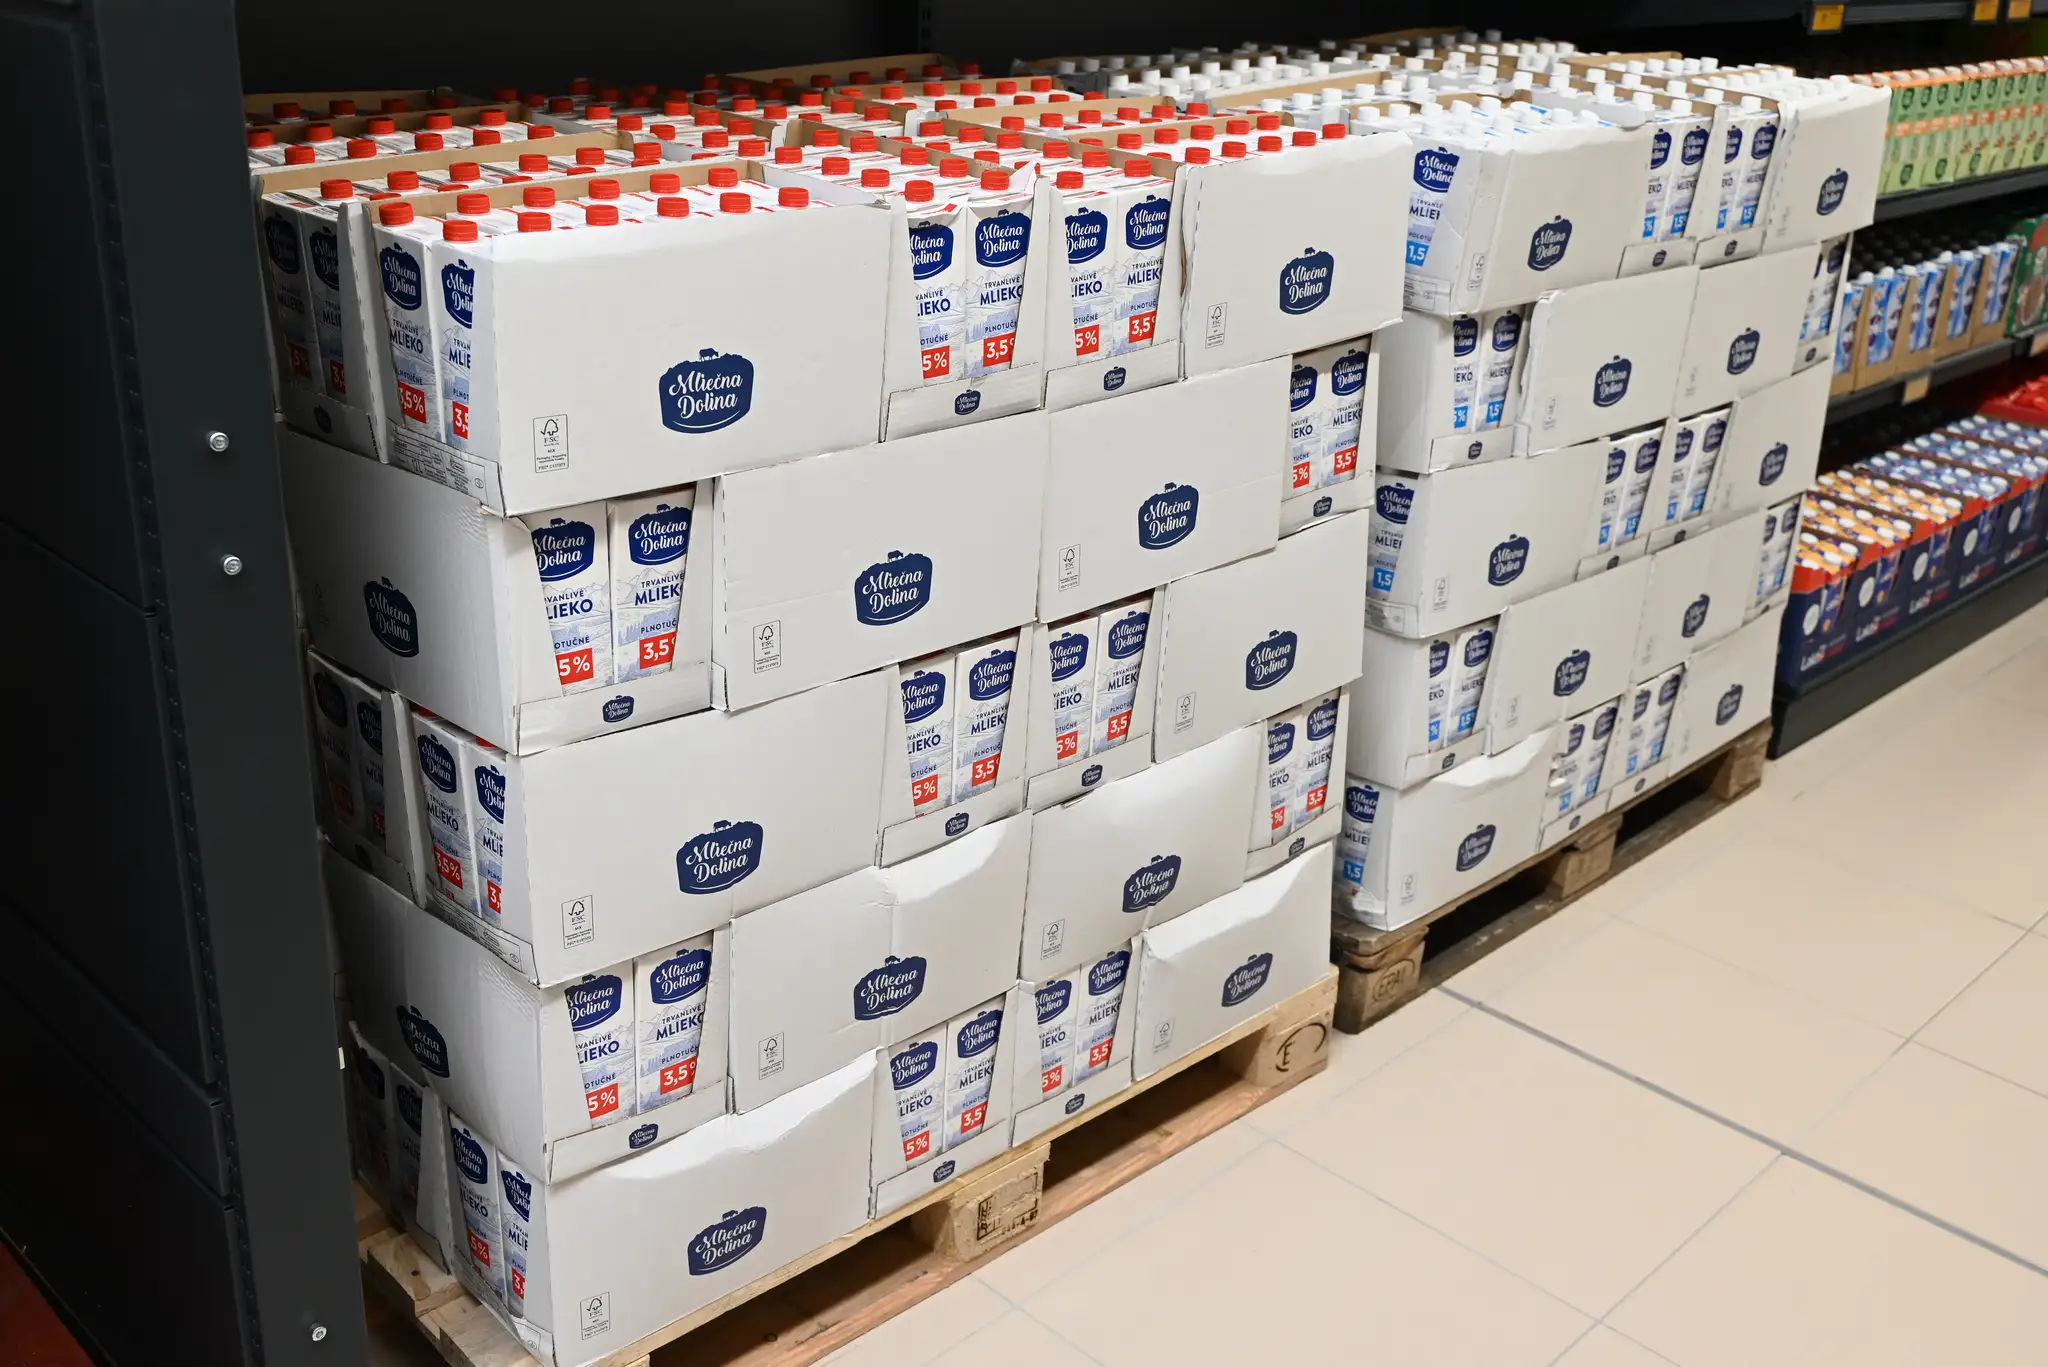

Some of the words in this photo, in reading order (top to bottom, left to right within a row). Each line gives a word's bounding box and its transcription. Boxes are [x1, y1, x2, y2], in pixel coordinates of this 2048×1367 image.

[979, 223, 1024, 242] Mliečna
[1133, 223, 1164, 240] Dolina
[983, 238, 1020, 256] Dolina
[1409, 245, 1426, 261] 1,5
[1284, 265, 1328, 286] Mliečna
[1072, 281, 1102, 298] IEKO
[1289, 283, 1323, 304] Dolina
[917, 300, 950, 317] IEKO
[389, 328, 424, 354] MLIEKO
[1076, 330, 1097, 348] 5%
[922, 351, 947, 371] 5%
[668, 371, 743, 397] Mliečna
[678, 392, 738, 419] Dolina
[1143, 500, 1192, 523] Mliečna
[635, 519, 688, 539] Mliečna
[1149, 515, 1188, 541] Dolina
[641, 535, 684, 555] Dolina
[537, 551, 582, 571] Dolina
[862, 567, 924, 597] Mliečna
[635, 583, 682, 606] MLIEK
[869, 586, 919, 614] Dolina
[643, 637, 675, 661] 3,5
[1115, 633, 1142, 651] Dolina
[560, 654, 590, 677] 5%
[974, 661, 1013, 680] Mliečna
[1254, 658, 1288, 682] Dolina
[977, 673, 1010, 693] Dolina
[975, 759, 999, 779] 3,5
[913, 780, 936, 799] 5%
[686, 838, 753, 865] Mliečna
[694, 854, 748, 883] Dolina
[1129, 866, 1174, 893] Mliečna
[1132, 882, 1169, 904] Dolina
[656, 957, 705, 983] Mliečna
[661, 971, 701, 996] Dolina
[860, 968, 918, 997] Mliečna
[866, 983, 913, 1011] Dolina
[961, 1019, 997, 1041] Mliečna
[965, 1029, 995, 1051] Dolina
[895, 1061, 928, 1083] Dolina
[588, 1088, 616, 1111] 5%
[964, 1106, 986, 1128] 3,5
[905, 1134, 928, 1156] 5%
[696, 1217, 758, 1254] Mliečna
[702, 1233, 753, 1265] Dolina
